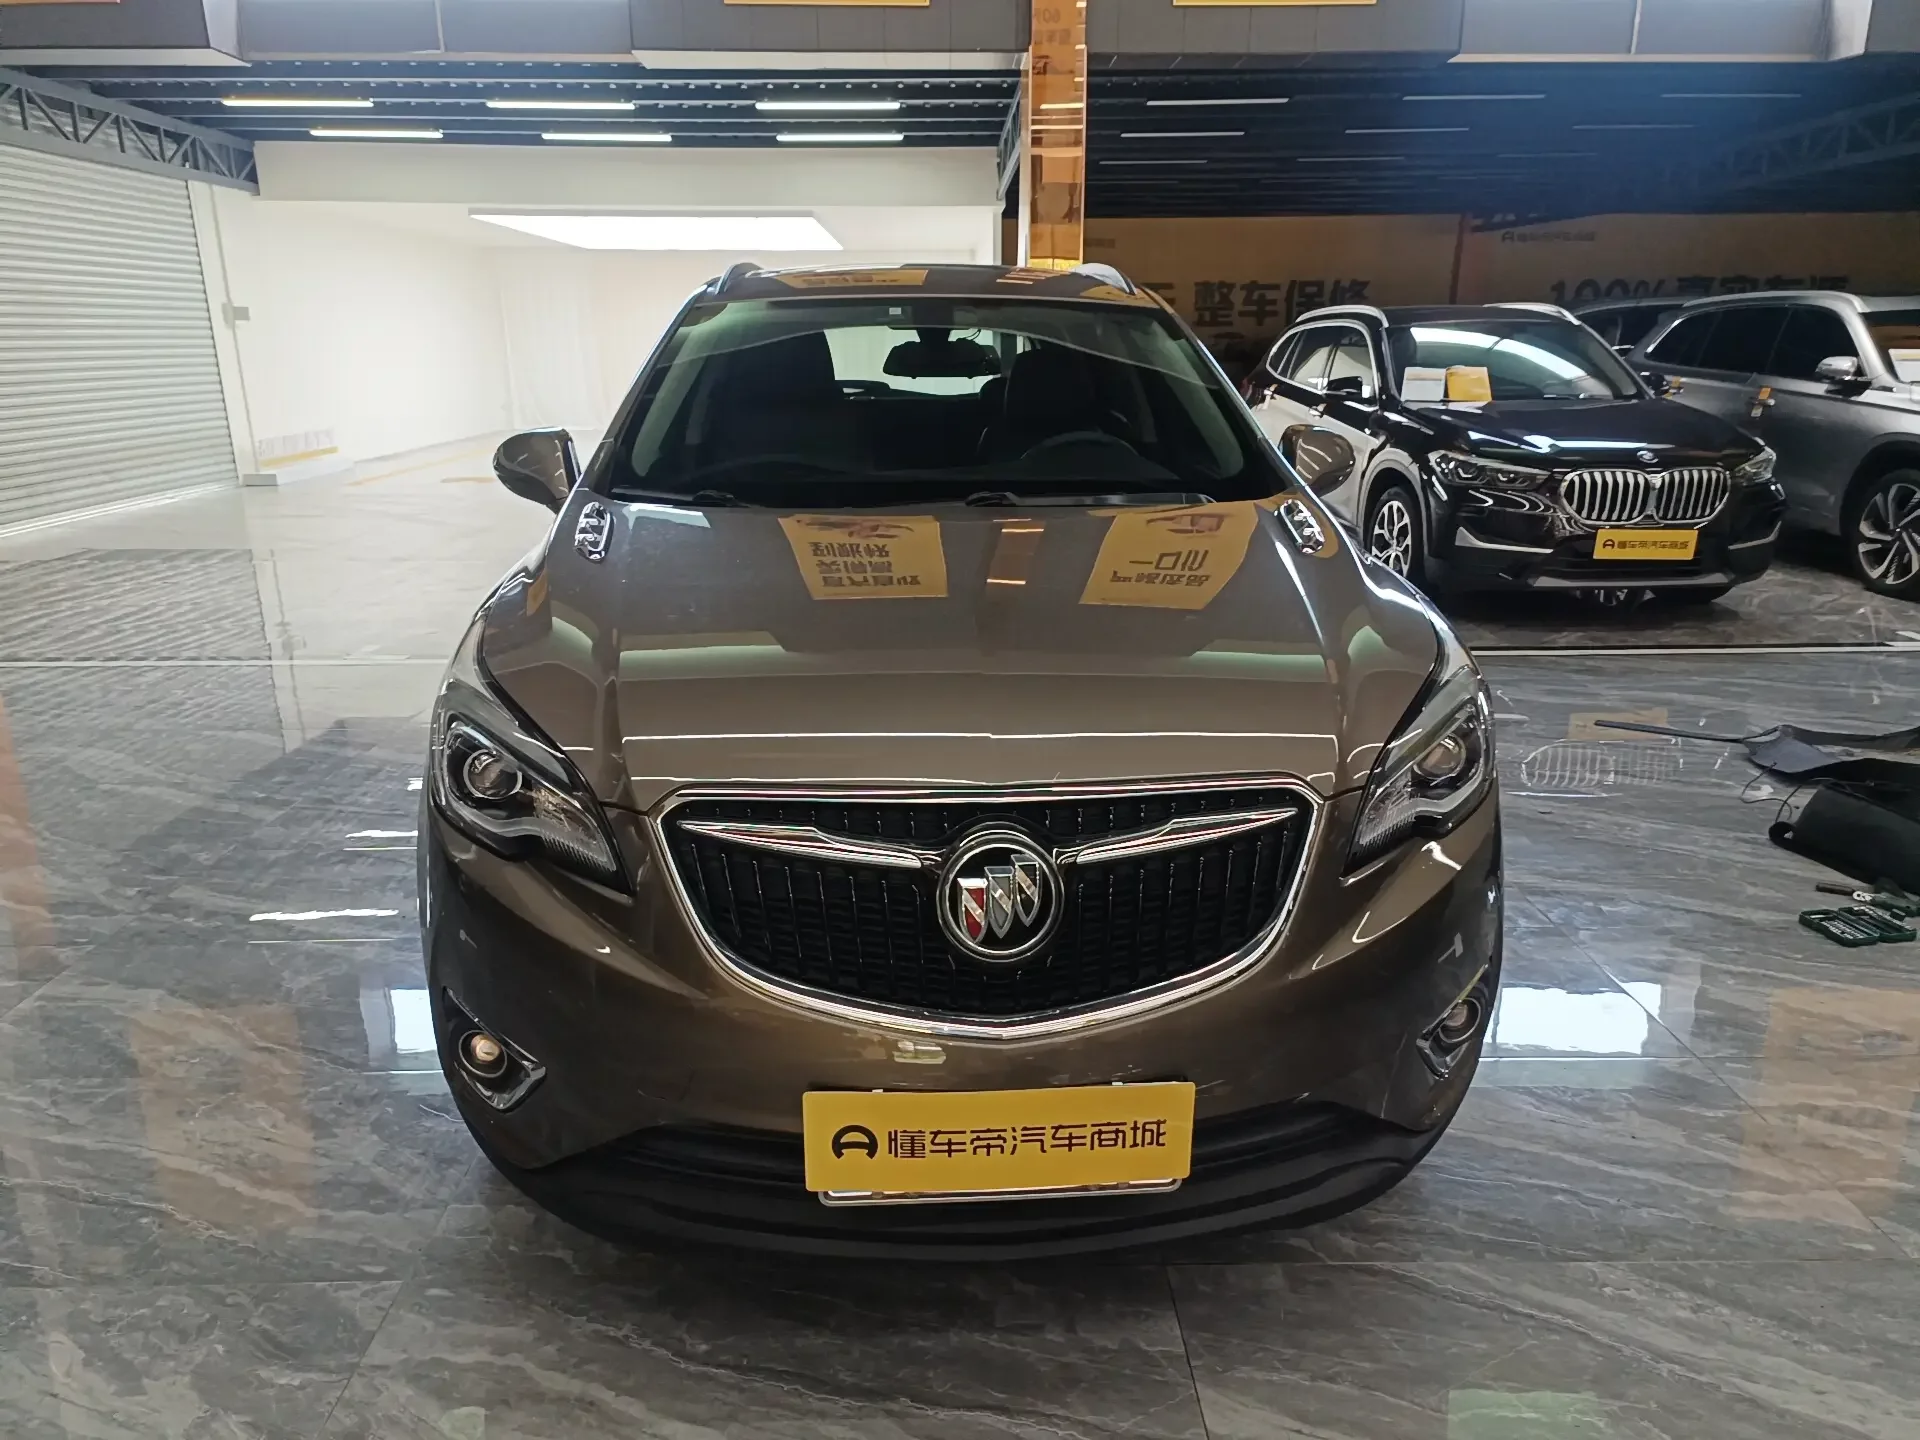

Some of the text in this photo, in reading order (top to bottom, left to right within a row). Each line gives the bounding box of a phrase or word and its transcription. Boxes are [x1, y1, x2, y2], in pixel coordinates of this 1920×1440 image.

[887, 1119, 1167, 1159] 懂车帝汽车商城
